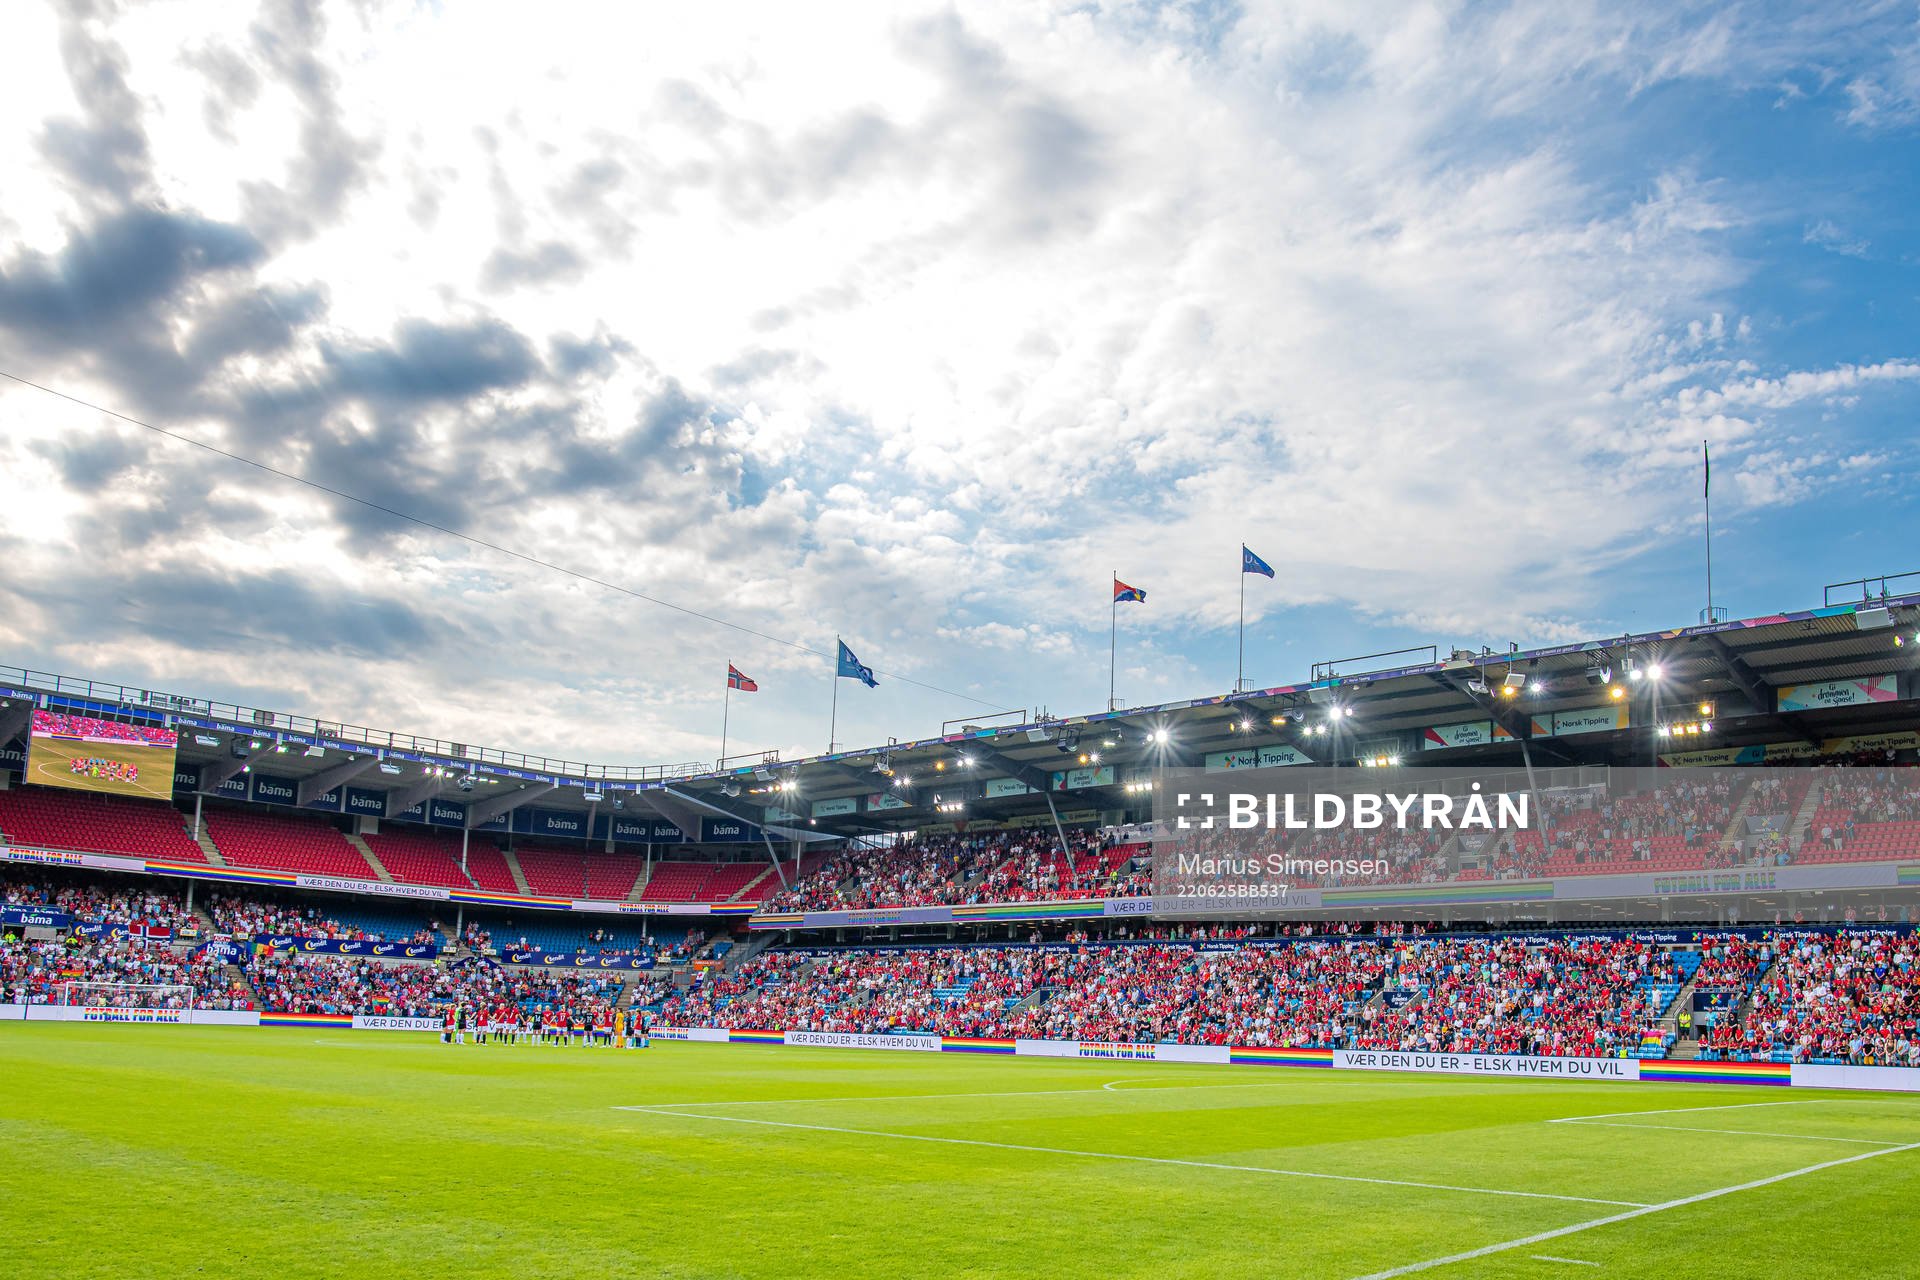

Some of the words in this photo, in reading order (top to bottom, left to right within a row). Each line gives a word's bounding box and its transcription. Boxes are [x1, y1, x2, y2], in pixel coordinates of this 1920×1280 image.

[1562, 718, 1582, 727] Norsk
[1584, 716, 1609, 727] Tipping
[1238, 754, 1262, 765] Norsk
[1264, 752, 1294, 764] Tipping
[1704, 754, 1728, 762] Tipping
[259, 782, 293, 798] bama
[351, 795, 382, 809] bama
[434, 806, 463, 820] bama
[547, 818, 577, 830] bama
[616, 824, 646, 836] bama
[655, 827, 680, 836] bama
[713, 825, 740, 835] bama
[8, 848, 44, 861] FOTBALL
[46, 852, 62, 862] FOR
[64, 853, 82, 864] ALLE
[375, 885, 394, 893] ELSK
[396, 887, 417, 895] HVEM
[1113, 901, 1135, 912] VÆR
[1138, 901, 1160, 911] DEN
[1164, 900, 1178, 910] DU
[1182, 899, 1194, 910] ER
[1206, 898, 1232, 909] ELSK
[1236, 897, 1268, 908] HVEM
[1272, 896, 1288, 906] DU
[1292, 895, 1310, 905] VIL
[21, 914, 52, 924] bama
[81, 925, 102, 934] Bendit
[275, 938, 292, 946] Bendit
[1654, 934, 1677, 942] Tipping
[310, 940, 327, 948] Bendit
[345, 942, 362, 950] Bendit
[378, 944, 394, 952] Bendit
[410, 946, 426, 954] Bendit
[549, 954, 564, 962] Bendit
[84, 1008, 130, 1021] FOTBALL
[133, 1009, 153, 1021] FOR
[156, 1010, 180, 1022] ALLE
[363, 1019, 387, 1027] VÆR
[415, 1020, 430, 1028] DU
[791, 1034, 807, 1043] VÆR
[810, 1035, 825, 1044] DEN
[828, 1035, 838, 1044] DU
[841, 1036, 850, 1045] ER
[858, 1037, 878, 1046] ELSK
[880, 1037, 904, 1047] HVEM
[906, 1038, 918, 1047] DU
[921, 1039, 934, 1048] VIL
[1080, 1043, 1114, 1057] FOTBALL
[1117, 1044, 1133, 1058] FOR
[1136, 1045, 1155, 1059] ALLE
[1346, 1054, 1376, 1066] VÆR
[1381, 1055, 1410, 1067] DEN
[1416, 1056, 1435, 1067] DU
[1441, 1057, 1459, 1069] ER
[1475, 1058, 1511, 1071] ELSK
[1518, 1059, 1562, 1072] HVEM
[1569, 1061, 1591, 1074] DU
[1598, 1062, 1623, 1075] VIL
